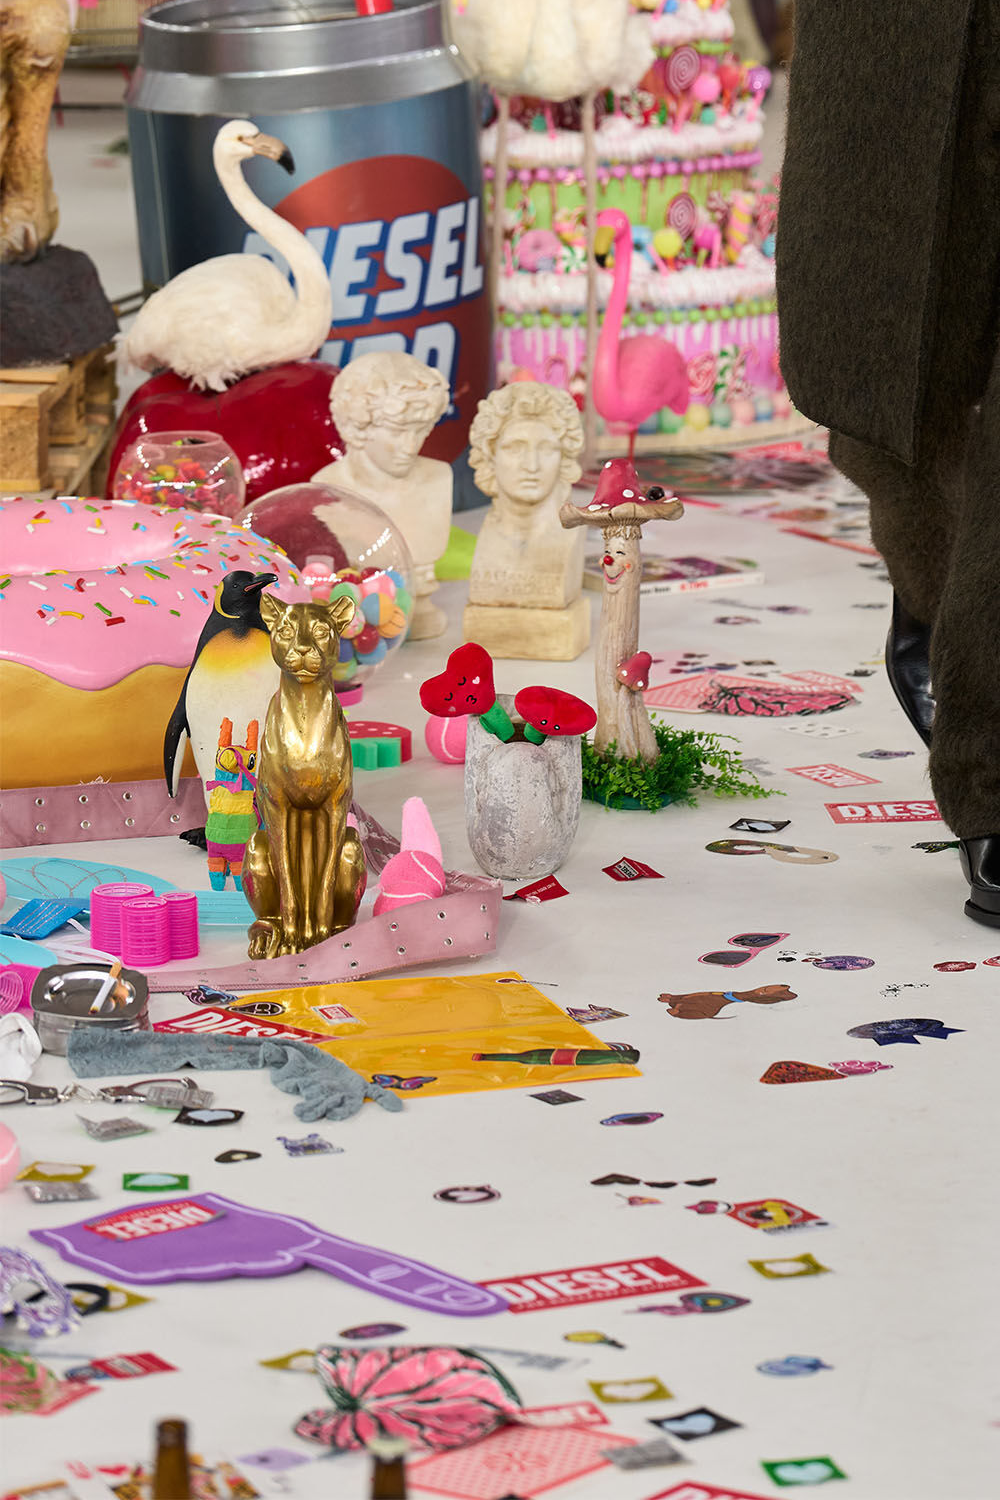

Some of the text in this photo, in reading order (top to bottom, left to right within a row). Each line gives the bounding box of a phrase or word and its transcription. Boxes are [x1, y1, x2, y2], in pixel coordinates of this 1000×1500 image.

[837, 803, 936, 818] DIES
[97, 1206, 212, 1239] DIESEL
[487, 1261, 681, 1301] DIESEL
